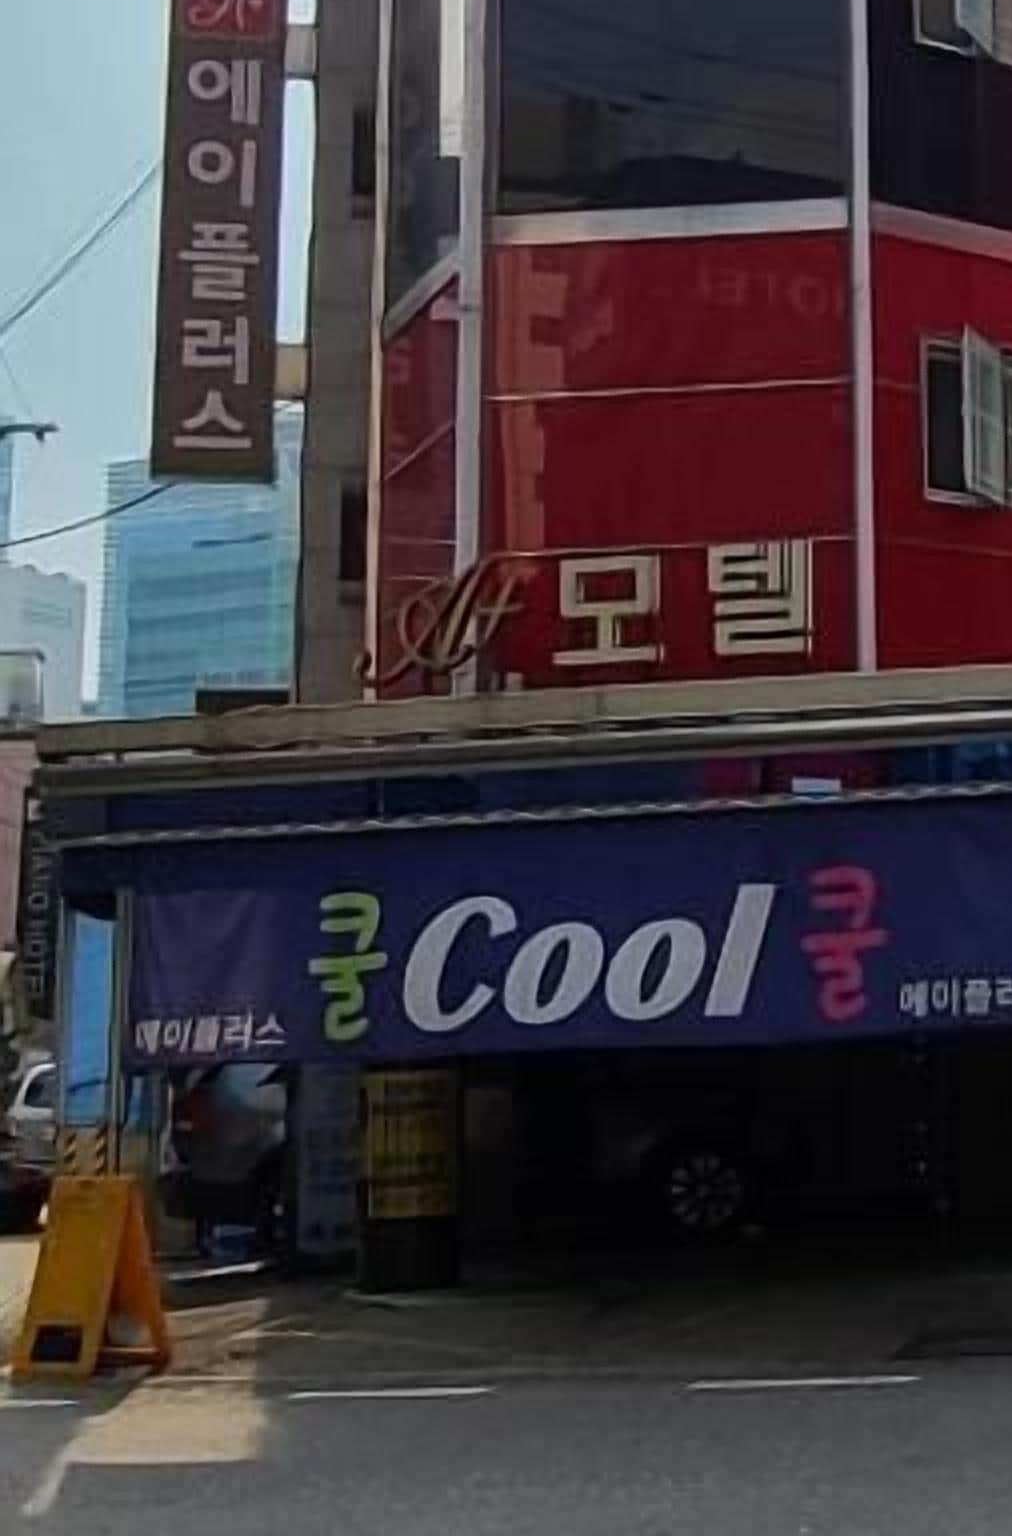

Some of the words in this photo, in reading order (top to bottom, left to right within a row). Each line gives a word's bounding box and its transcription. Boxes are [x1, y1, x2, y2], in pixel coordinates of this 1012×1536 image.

[173, 59, 262, 449] 에이플러스
[552, 539, 815, 666] 모텔
[308, 891, 388, 1041] 쿨
[402, 882, 778, 1033] Cool
[802, 863, 889, 1020] 쿨
